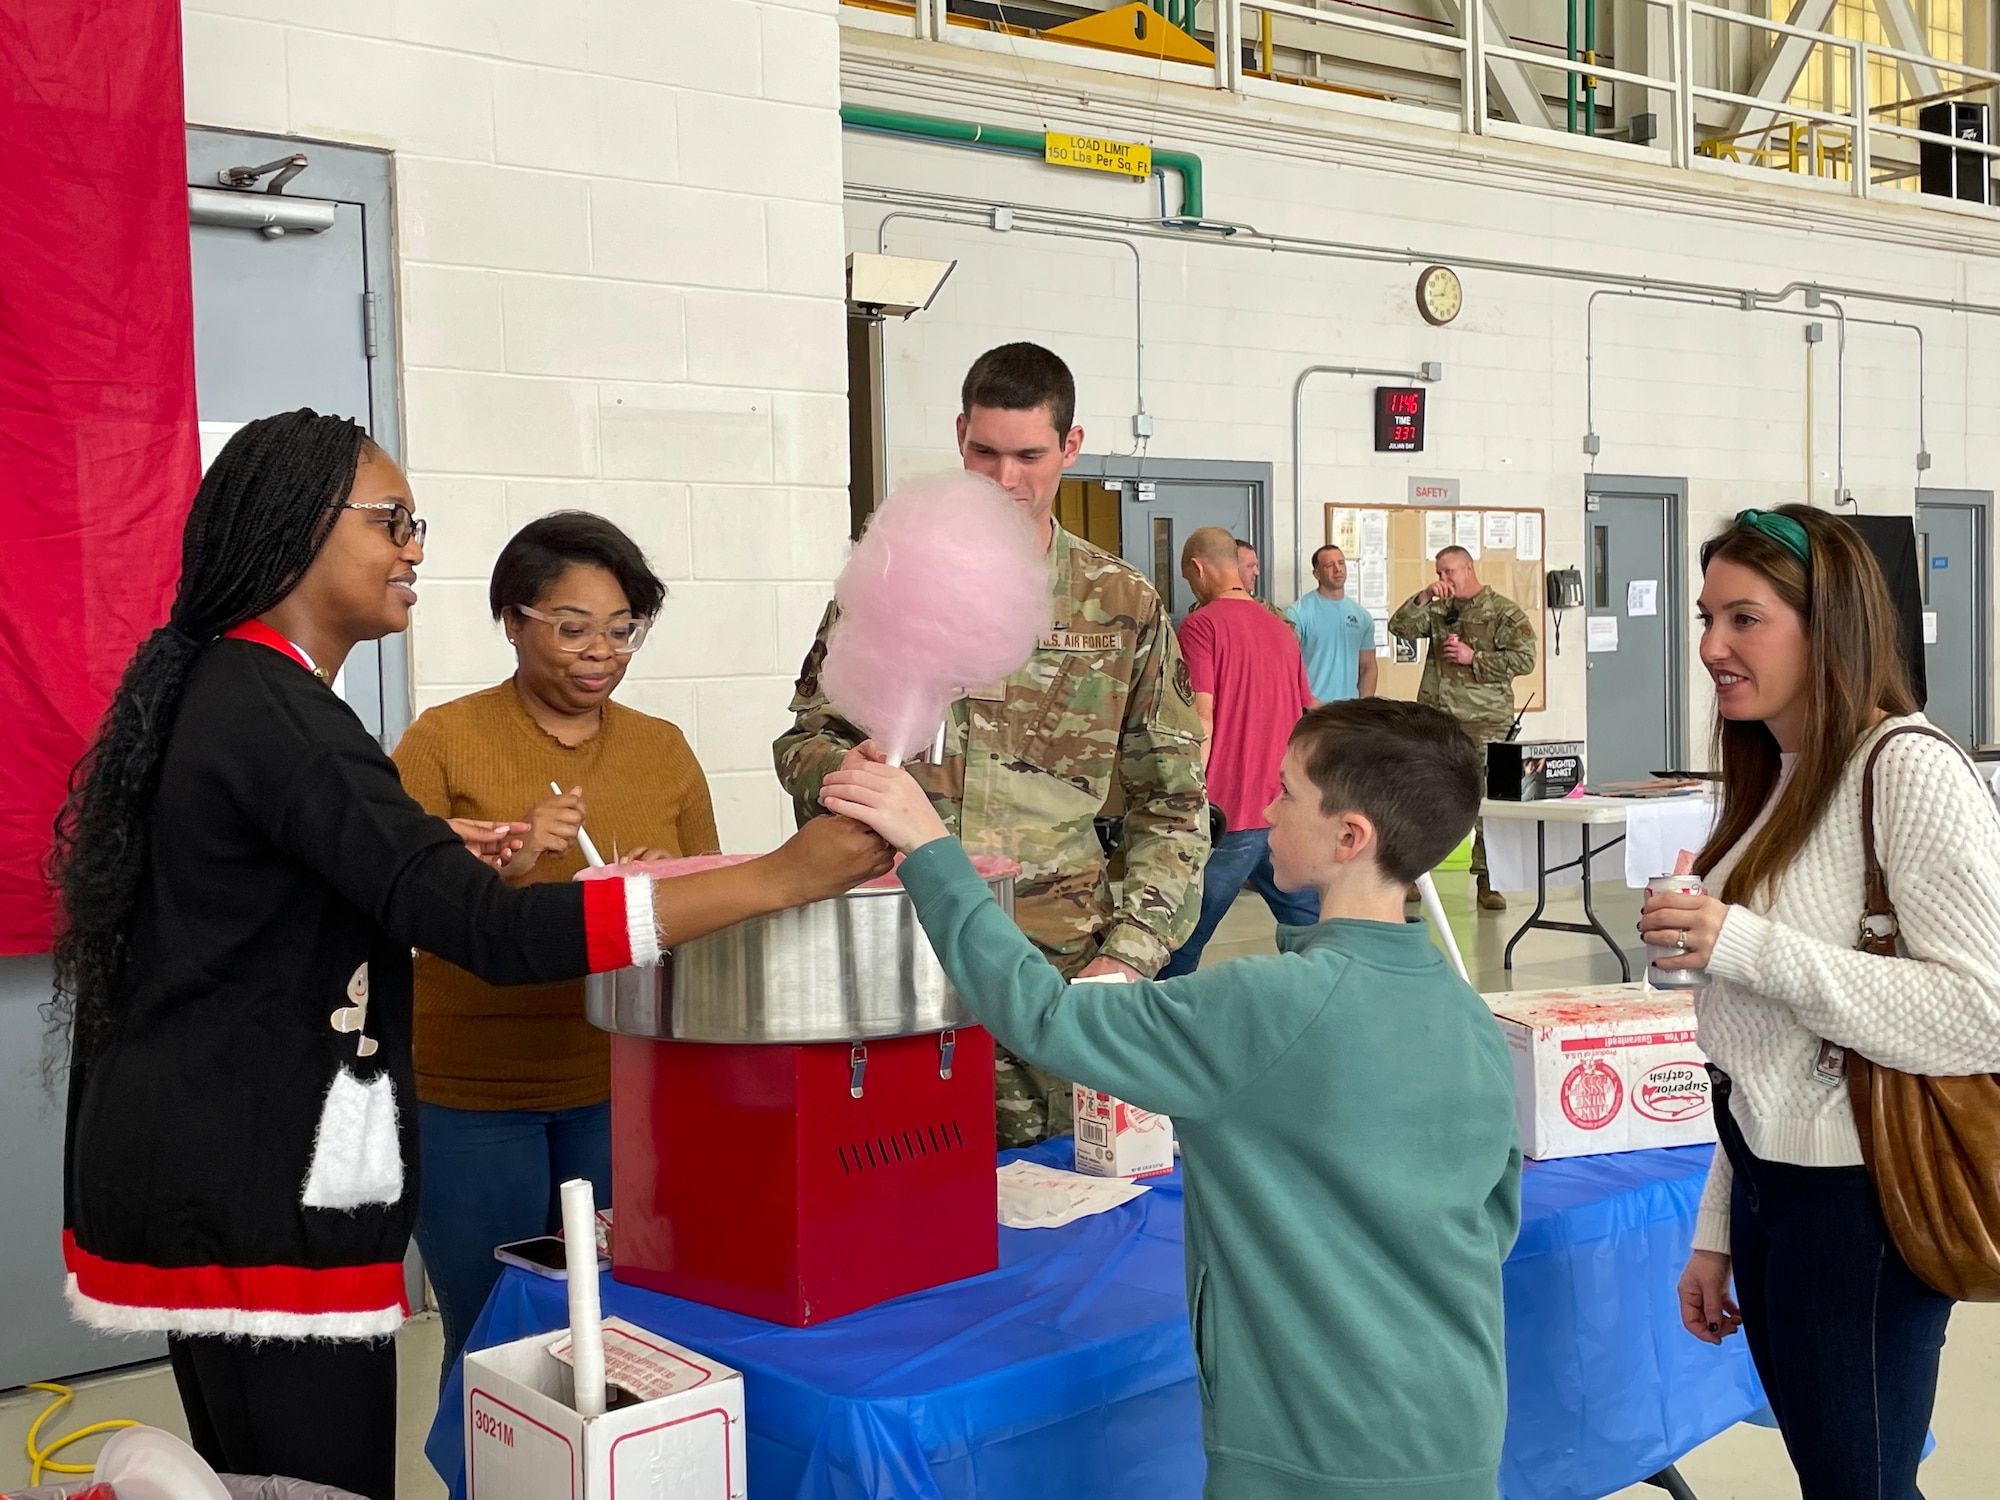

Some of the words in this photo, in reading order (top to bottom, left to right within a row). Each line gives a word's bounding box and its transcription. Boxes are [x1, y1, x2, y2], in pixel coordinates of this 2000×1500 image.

[1070, 137, 1100, 151] LOAD
[1104, 142, 1130, 156] LIMIT
[1048, 147, 1068, 159] 150
[1072, 150, 1092, 163] Lbs
[1096, 153, 1113, 167] Per
[1117, 158, 1133, 172] Sq.
[1137, 161, 1150, 173] Ft.
[1394, 416, 1412, 426] TIME
[1394, 426, 1416, 440] 337
[1416, 486, 1448, 498] SAFETY
[1064, 634, 1080, 648] AIR
[1082, 635, 1116, 648] FORCE
[1528, 744, 1578, 756] TRANQUILITY
[1546, 759, 1576, 768] WEIGHTED
[1546, 768, 1572, 778] BLANKET
[1592, 1050, 1617, 1058] Product
[1650, 1070, 1693, 1082] Catfish
[1655, 1081, 1708, 1096] Superior
[476, 1409, 514, 1448] 3021M
